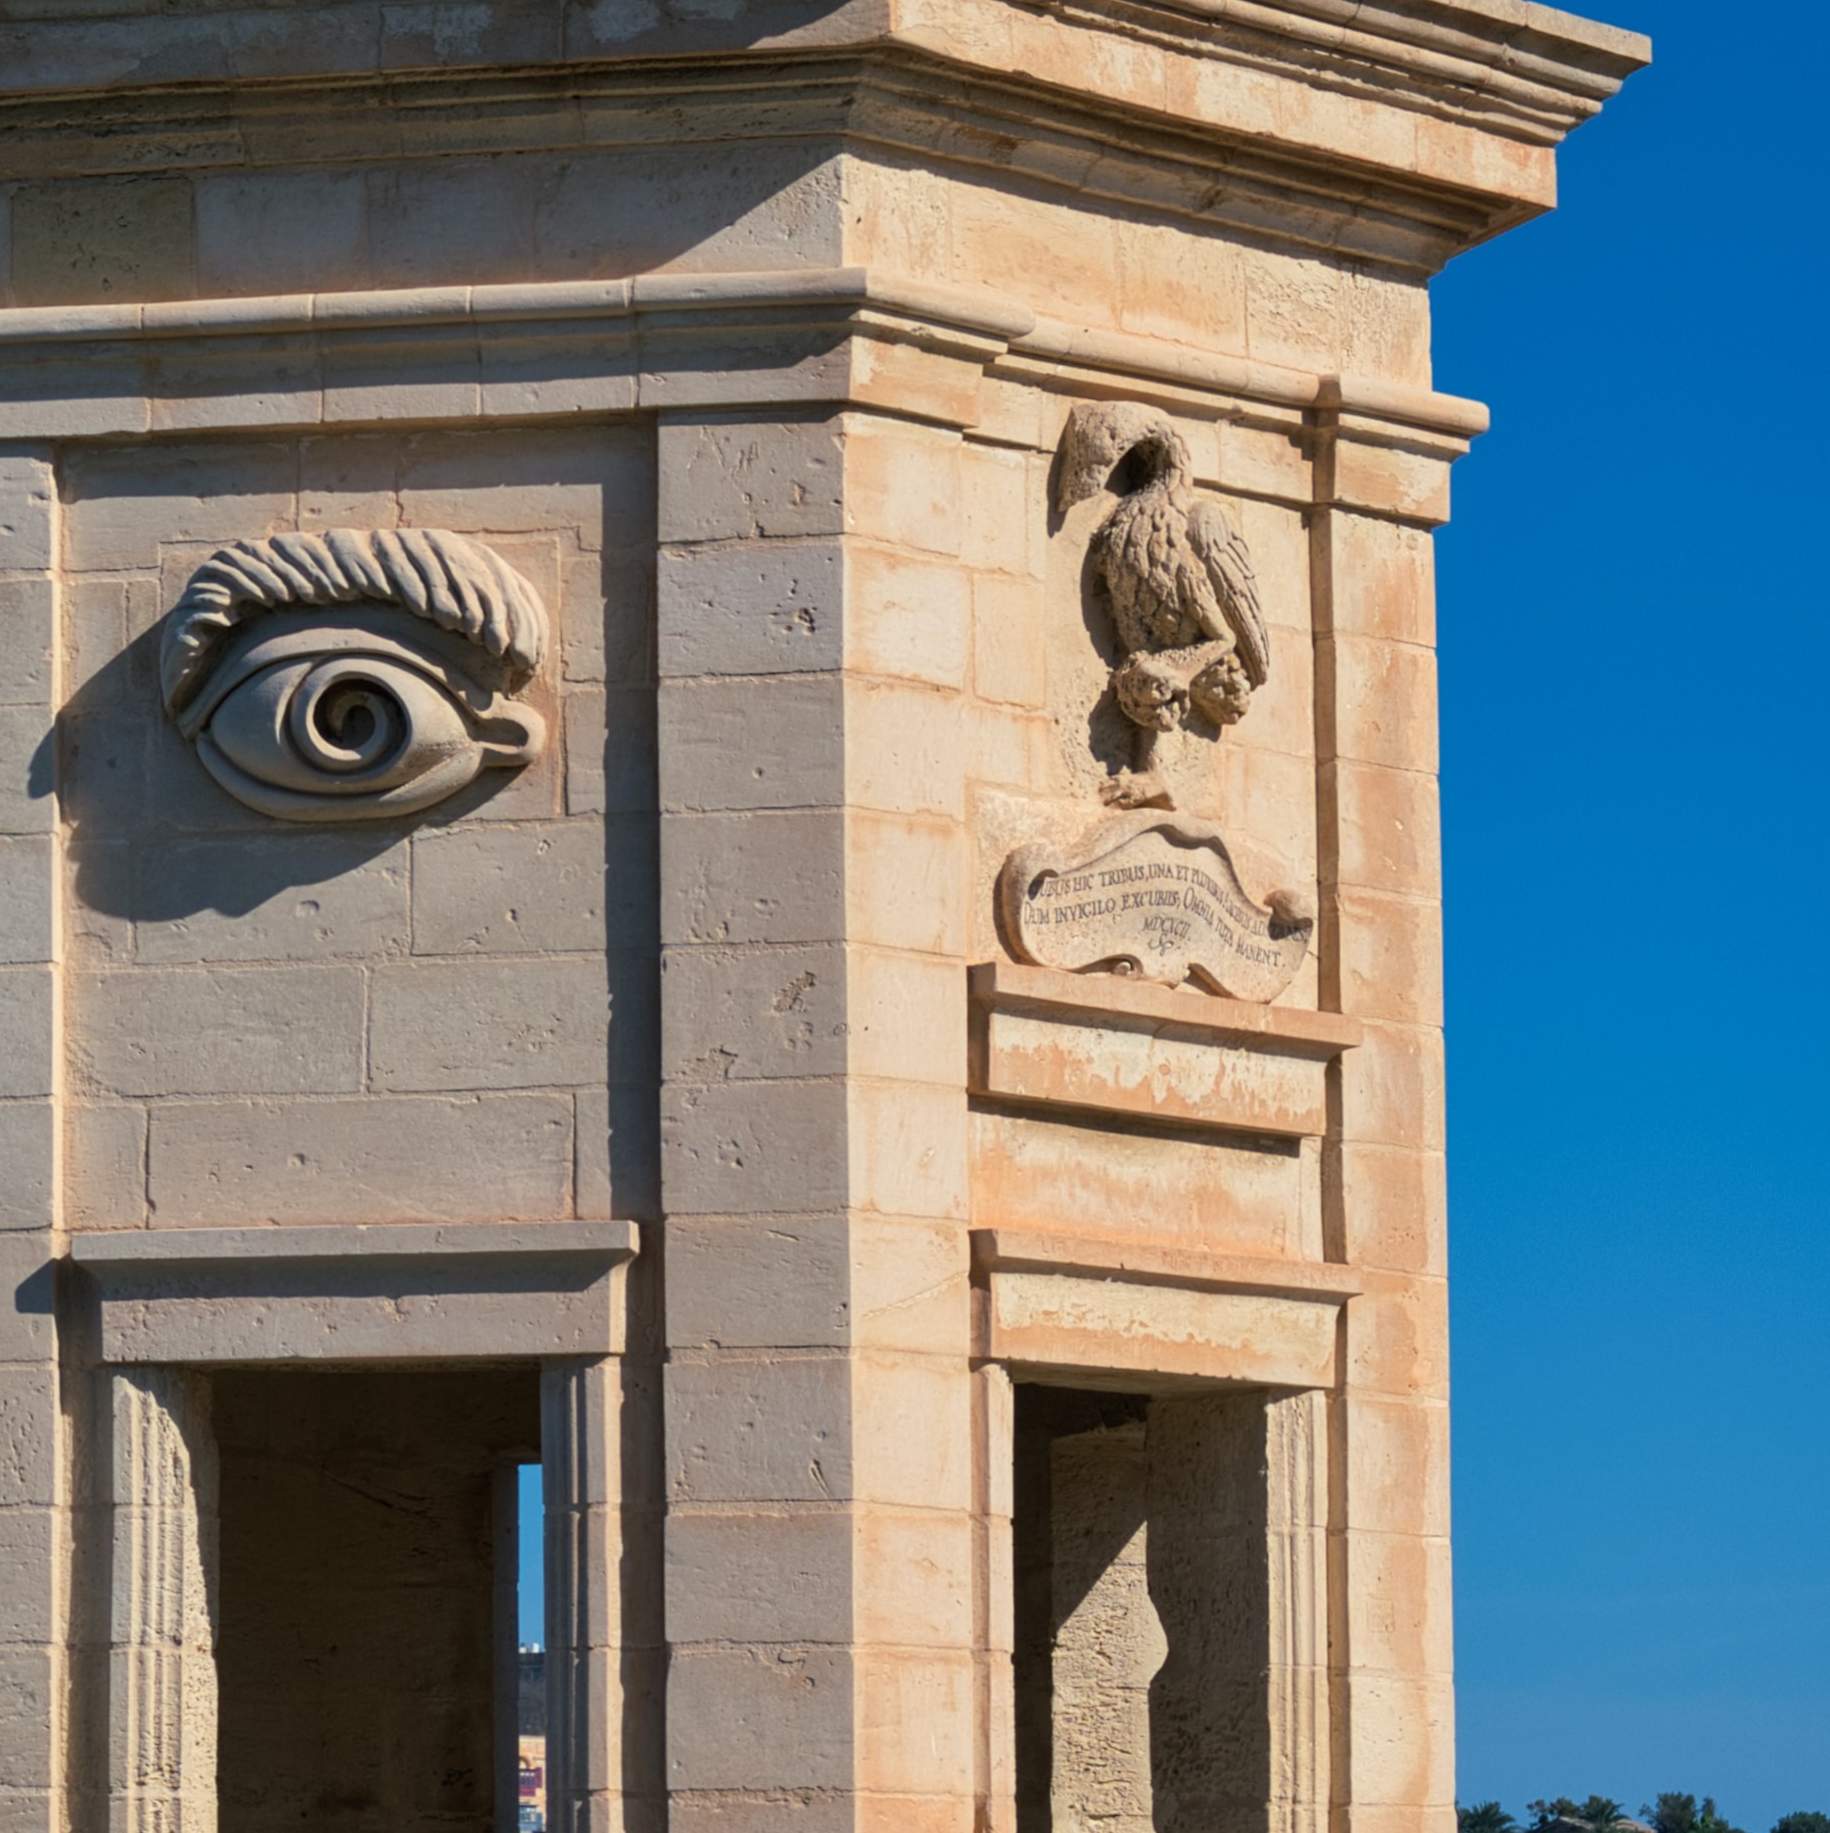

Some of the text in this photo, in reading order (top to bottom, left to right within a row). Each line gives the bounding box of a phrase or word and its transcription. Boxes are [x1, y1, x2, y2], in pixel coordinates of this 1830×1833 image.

[1073, 874, 1094, 892] HIC
[1098, 866, 1148, 887] TRIBUS,
[1148, 864, 1173, 879] UNA
[1176, 864, 1189, 881] ET
